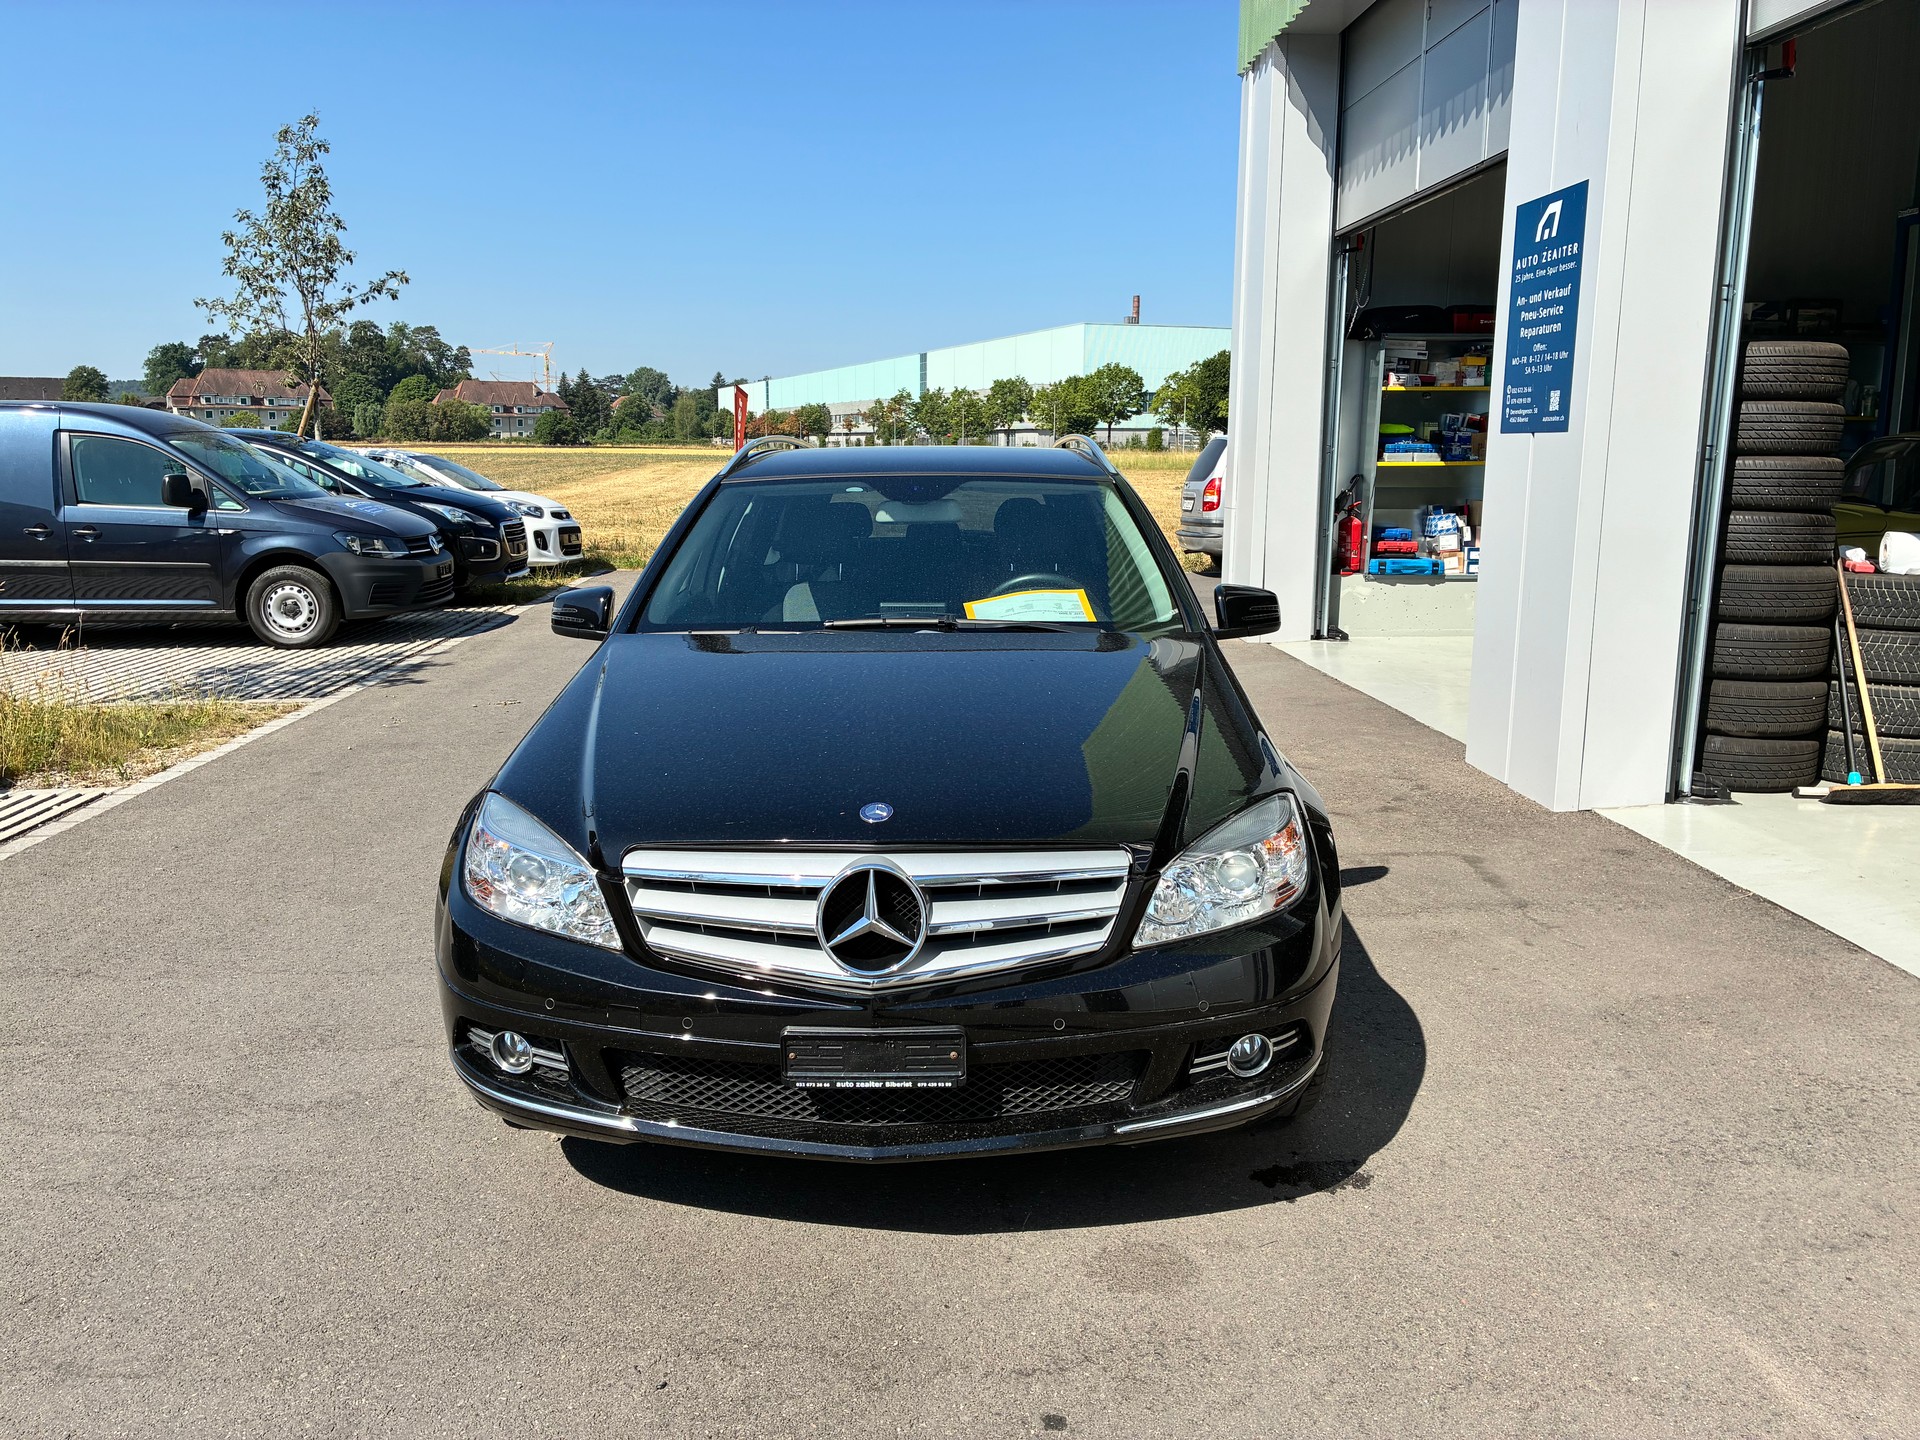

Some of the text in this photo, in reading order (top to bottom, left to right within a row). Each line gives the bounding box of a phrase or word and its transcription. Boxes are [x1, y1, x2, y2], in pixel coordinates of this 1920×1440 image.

[1516, 242, 1578, 270] AUTO ZEAITER
[1515, 261, 1577, 283] 25 Jahre. Eine Spur besser.
[1517, 283, 1571, 306] An- und Verkauf
[1521, 304, 1563, 322] Pneu-Service
[1520, 323, 1561, 339] Reparaturen
[1533, 343, 1547, 352] Offen:
[1512, 356, 1527, 365] MO-FR
[1529, 354, 1540, 363] 8-12
[1545, 352, 1558, 361] 14-18
[1559, 351, 1569, 359] Uhr
[1525, 364, 1552, 374] SA 9-13 Uhr
